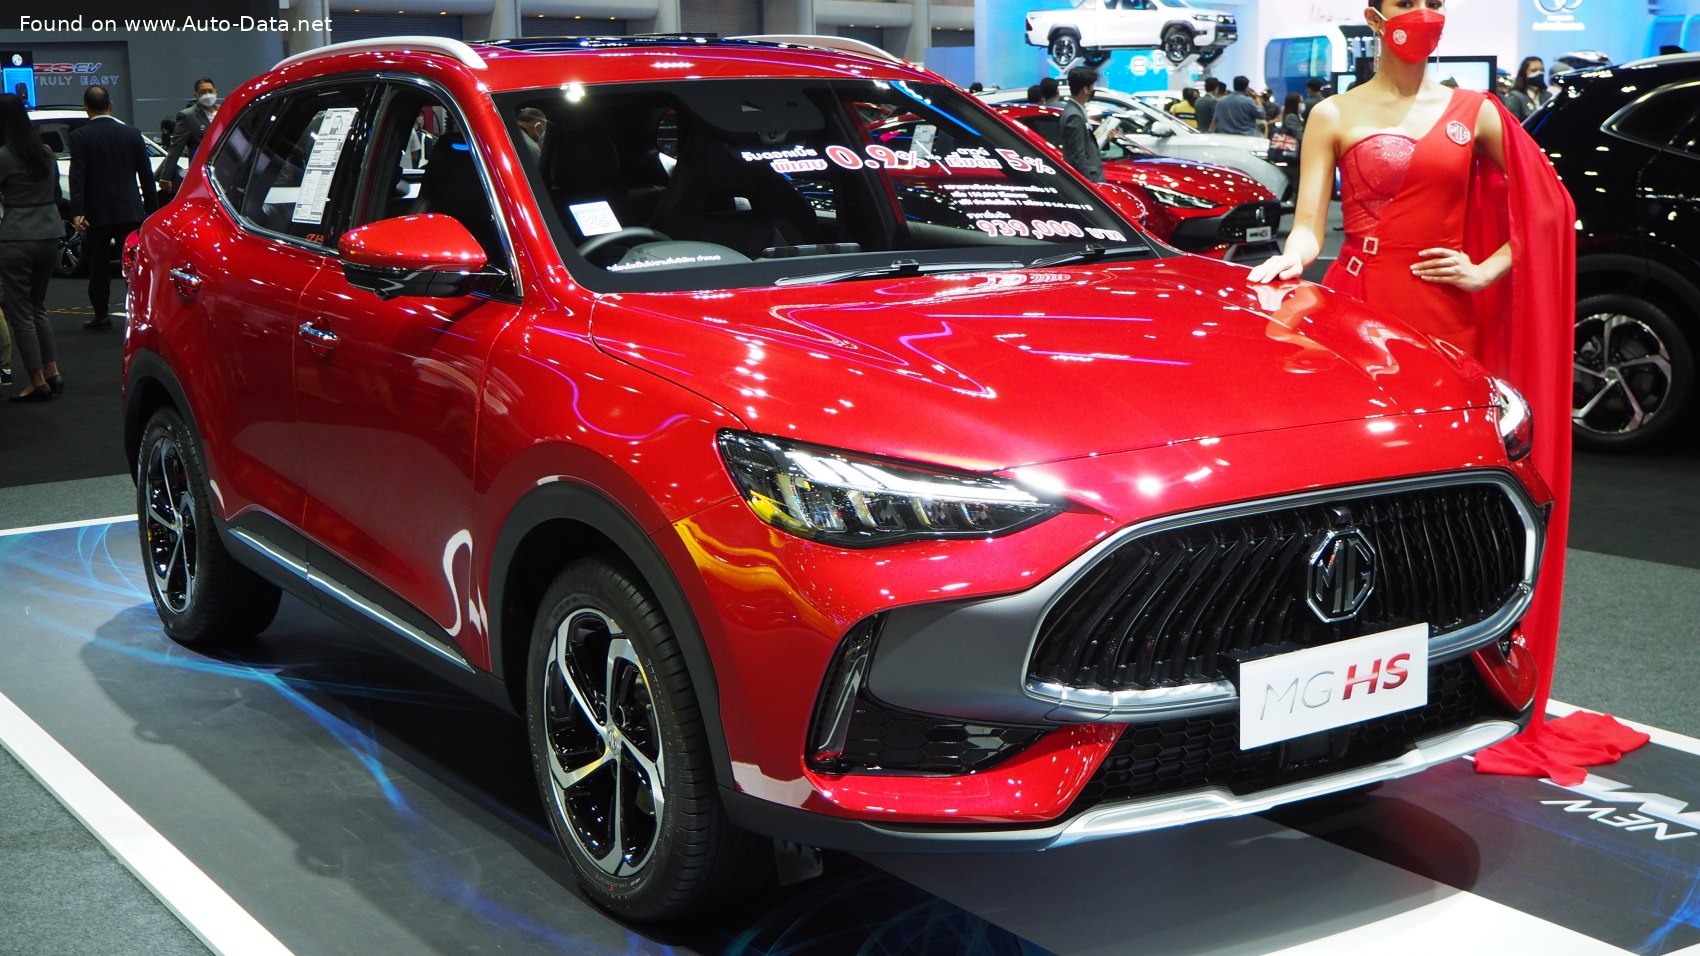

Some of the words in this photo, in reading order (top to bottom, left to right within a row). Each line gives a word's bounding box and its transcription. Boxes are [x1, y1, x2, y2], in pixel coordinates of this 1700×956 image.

[80, 75, 119, 86] EASY
[1448, 121, 1469, 143] MG
[825, 144, 931, 170] 0.9%
[995, 148, 1057, 175] 5%
[976, 219, 1085, 239] 939,000
[1314, 535, 1374, 616] MG
[1259, 669, 1334, 721] MG
[1341, 651, 1411, 700] HS
[1539, 799, 1698, 842] NEW
